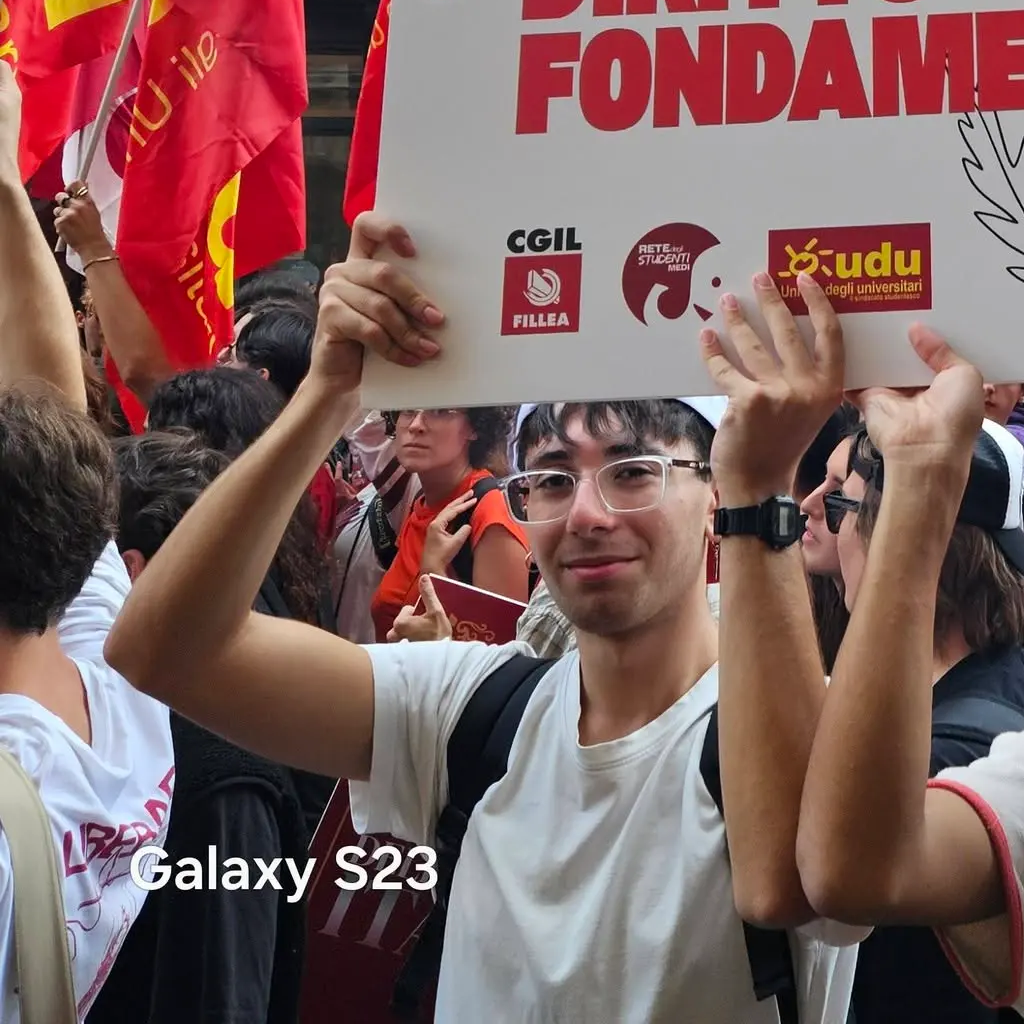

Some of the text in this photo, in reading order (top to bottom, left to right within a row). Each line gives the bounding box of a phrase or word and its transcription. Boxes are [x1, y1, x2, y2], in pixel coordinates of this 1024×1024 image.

[506, 227, 582, 254] CGIL
[638, 243, 671, 254] RETE
[638, 253, 691, 266] STUDENTI
[667, 263, 691, 272] MEDI
[835, 241, 921, 279] udu
[826, 280, 854, 299] degli
[857, 278, 923, 295] universitari
[512, 312, 570, 329] FILLEA
